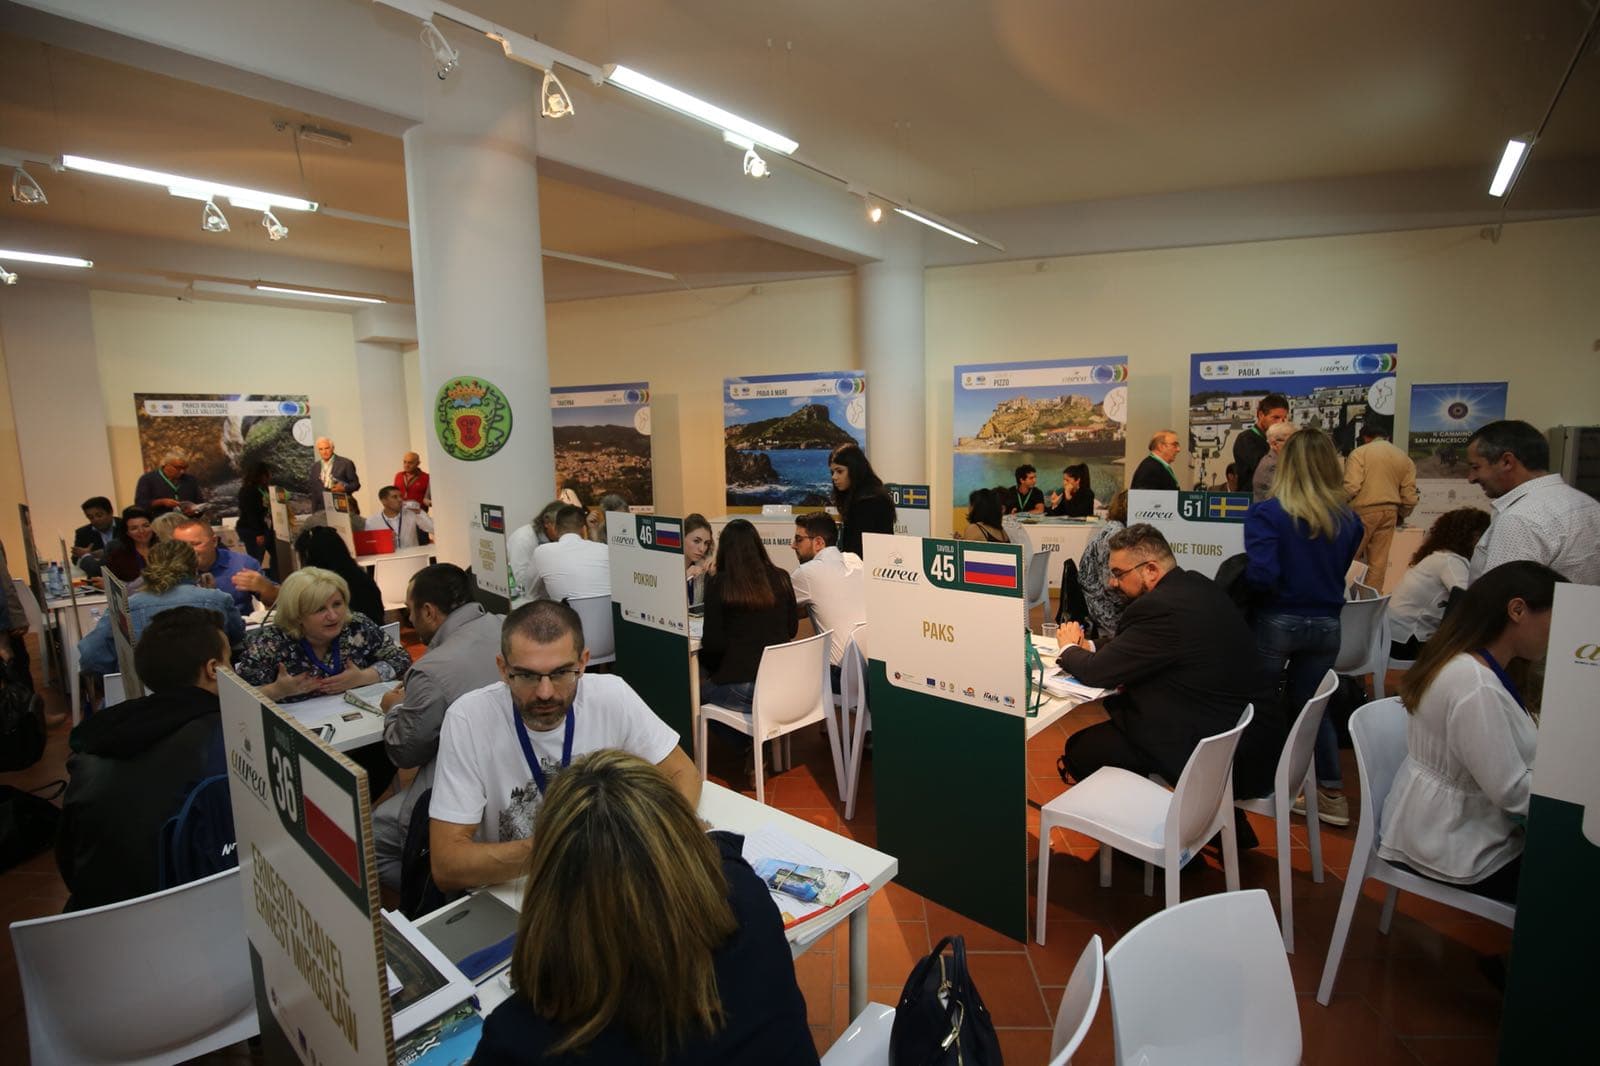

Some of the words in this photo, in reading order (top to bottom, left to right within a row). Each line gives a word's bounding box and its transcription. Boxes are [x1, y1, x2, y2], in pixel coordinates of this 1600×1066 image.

[1238, 368, 1260, 377] PAOLA
[993, 379, 1010, 387] PIZZO
[774, 388, 787, 396] MARE
[1134, 511, 1174, 519] aurea
[1183, 500, 1202, 518] 51
[640, 525, 653, 544] 46
[894, 524, 908, 534] ALIA
[777, 538, 792, 546] MARE
[936, 544, 954, 553] TAVOLO
[1041, 543, 1060, 552] PIZZO
[1170, 542, 1188, 555] NCE
[1190, 543, 1223, 557] TOURS
[872, 567, 918, 582] aurea
[930, 553, 955, 582] 45
[633, 571, 658, 588] POKROV
[922, 620, 955, 643] PAKS
[231, 749, 268, 801] aurea
[271, 745, 298, 823] 36
[251, 841, 298, 930] ERNESTO
[298, 898, 349, 999] TRAVEL
[253, 877, 291, 957] ERNEST
[290, 928, 359, 1054] MIROSLAW
